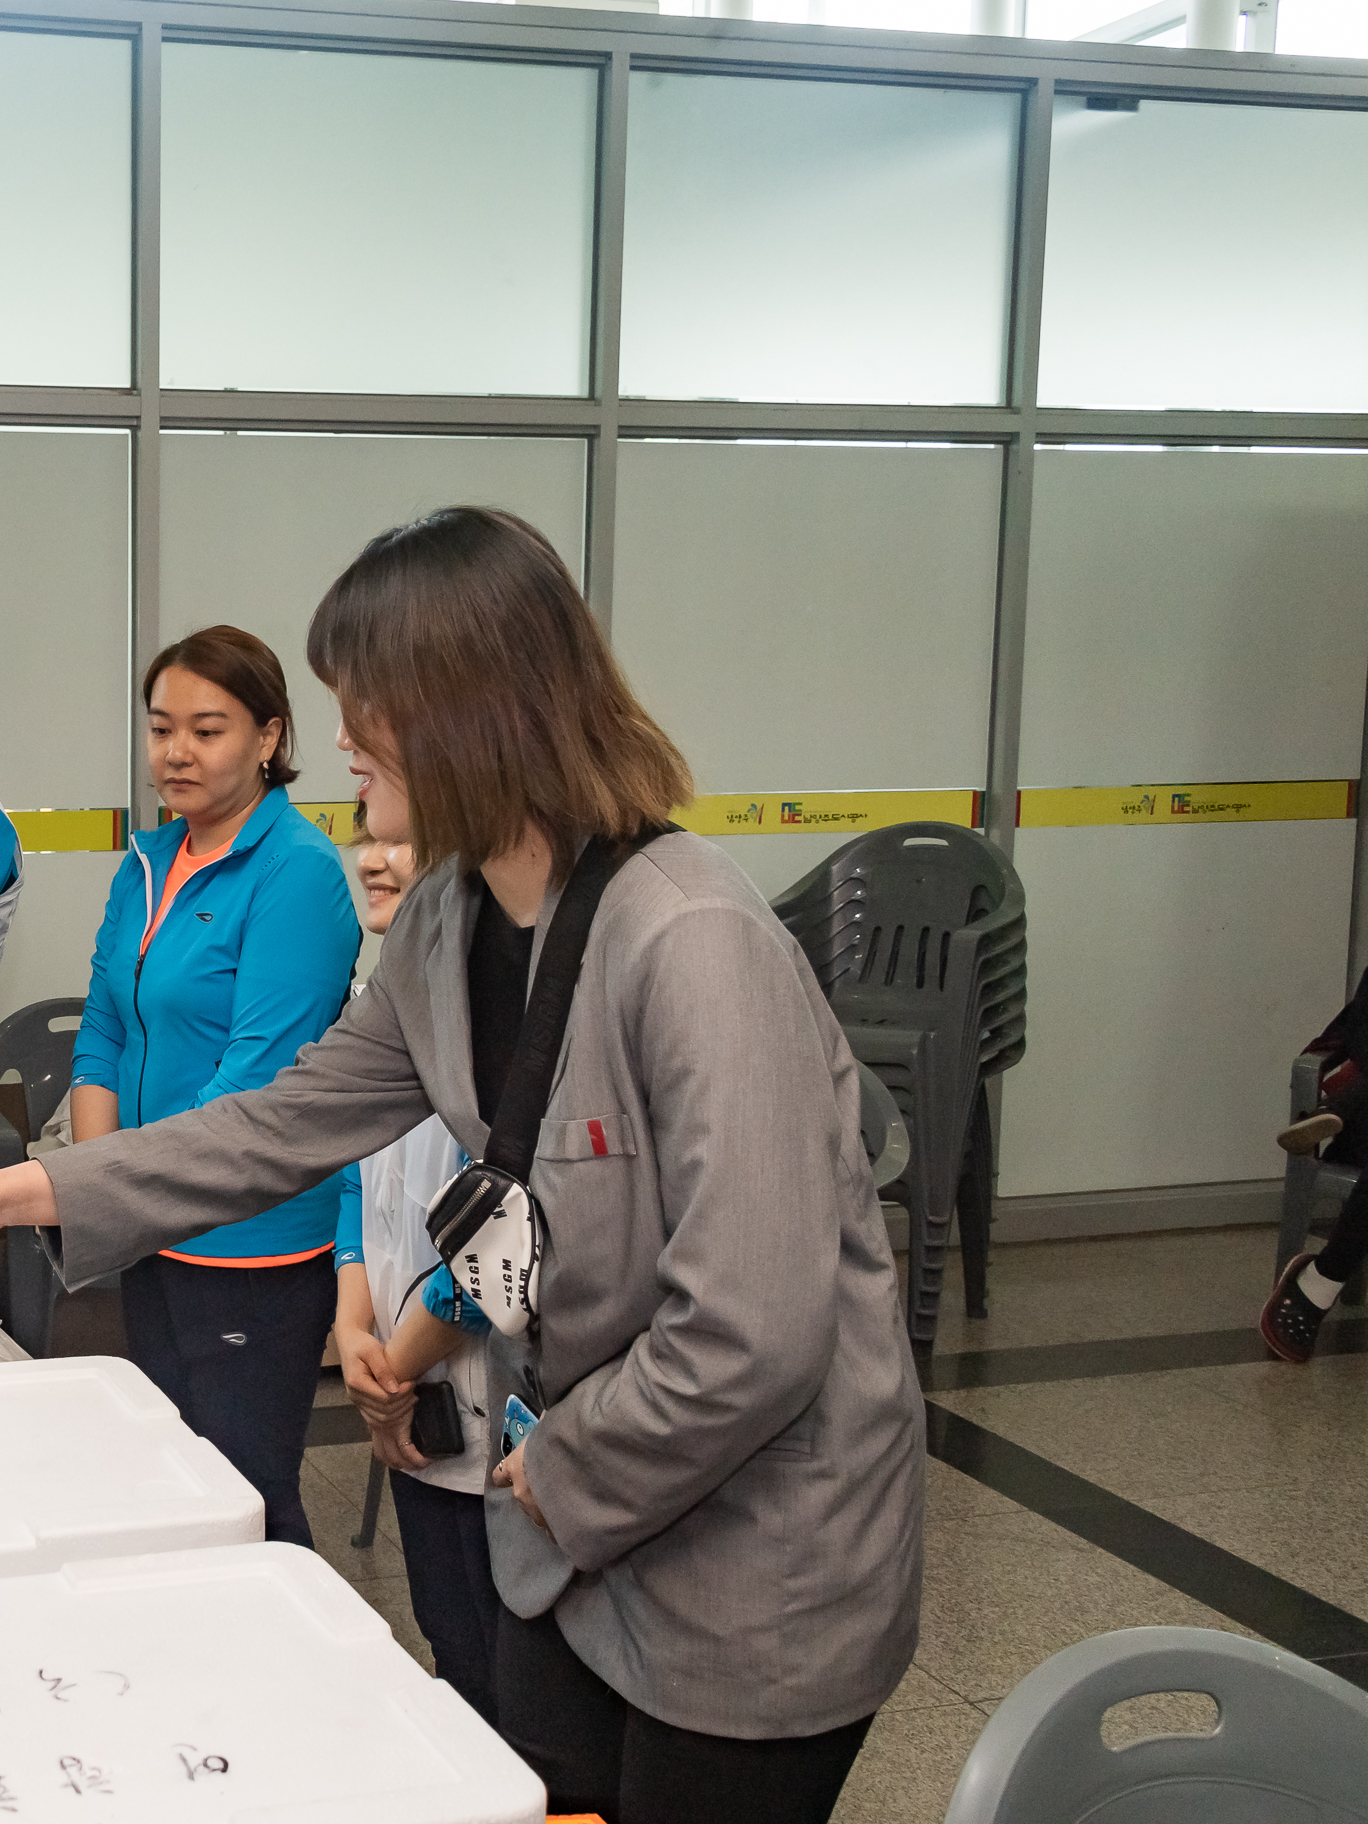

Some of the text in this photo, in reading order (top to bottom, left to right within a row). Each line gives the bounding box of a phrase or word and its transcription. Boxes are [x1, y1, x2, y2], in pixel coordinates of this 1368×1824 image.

[1191, 803, 1251, 815] 남양주도시공사
[726, 813, 750, 824] 남양주
[803, 812, 868, 824] 남양주도시공사
[464, 1253, 483, 1301] MSGM
[501, 1258, 513, 1309] MSGM
